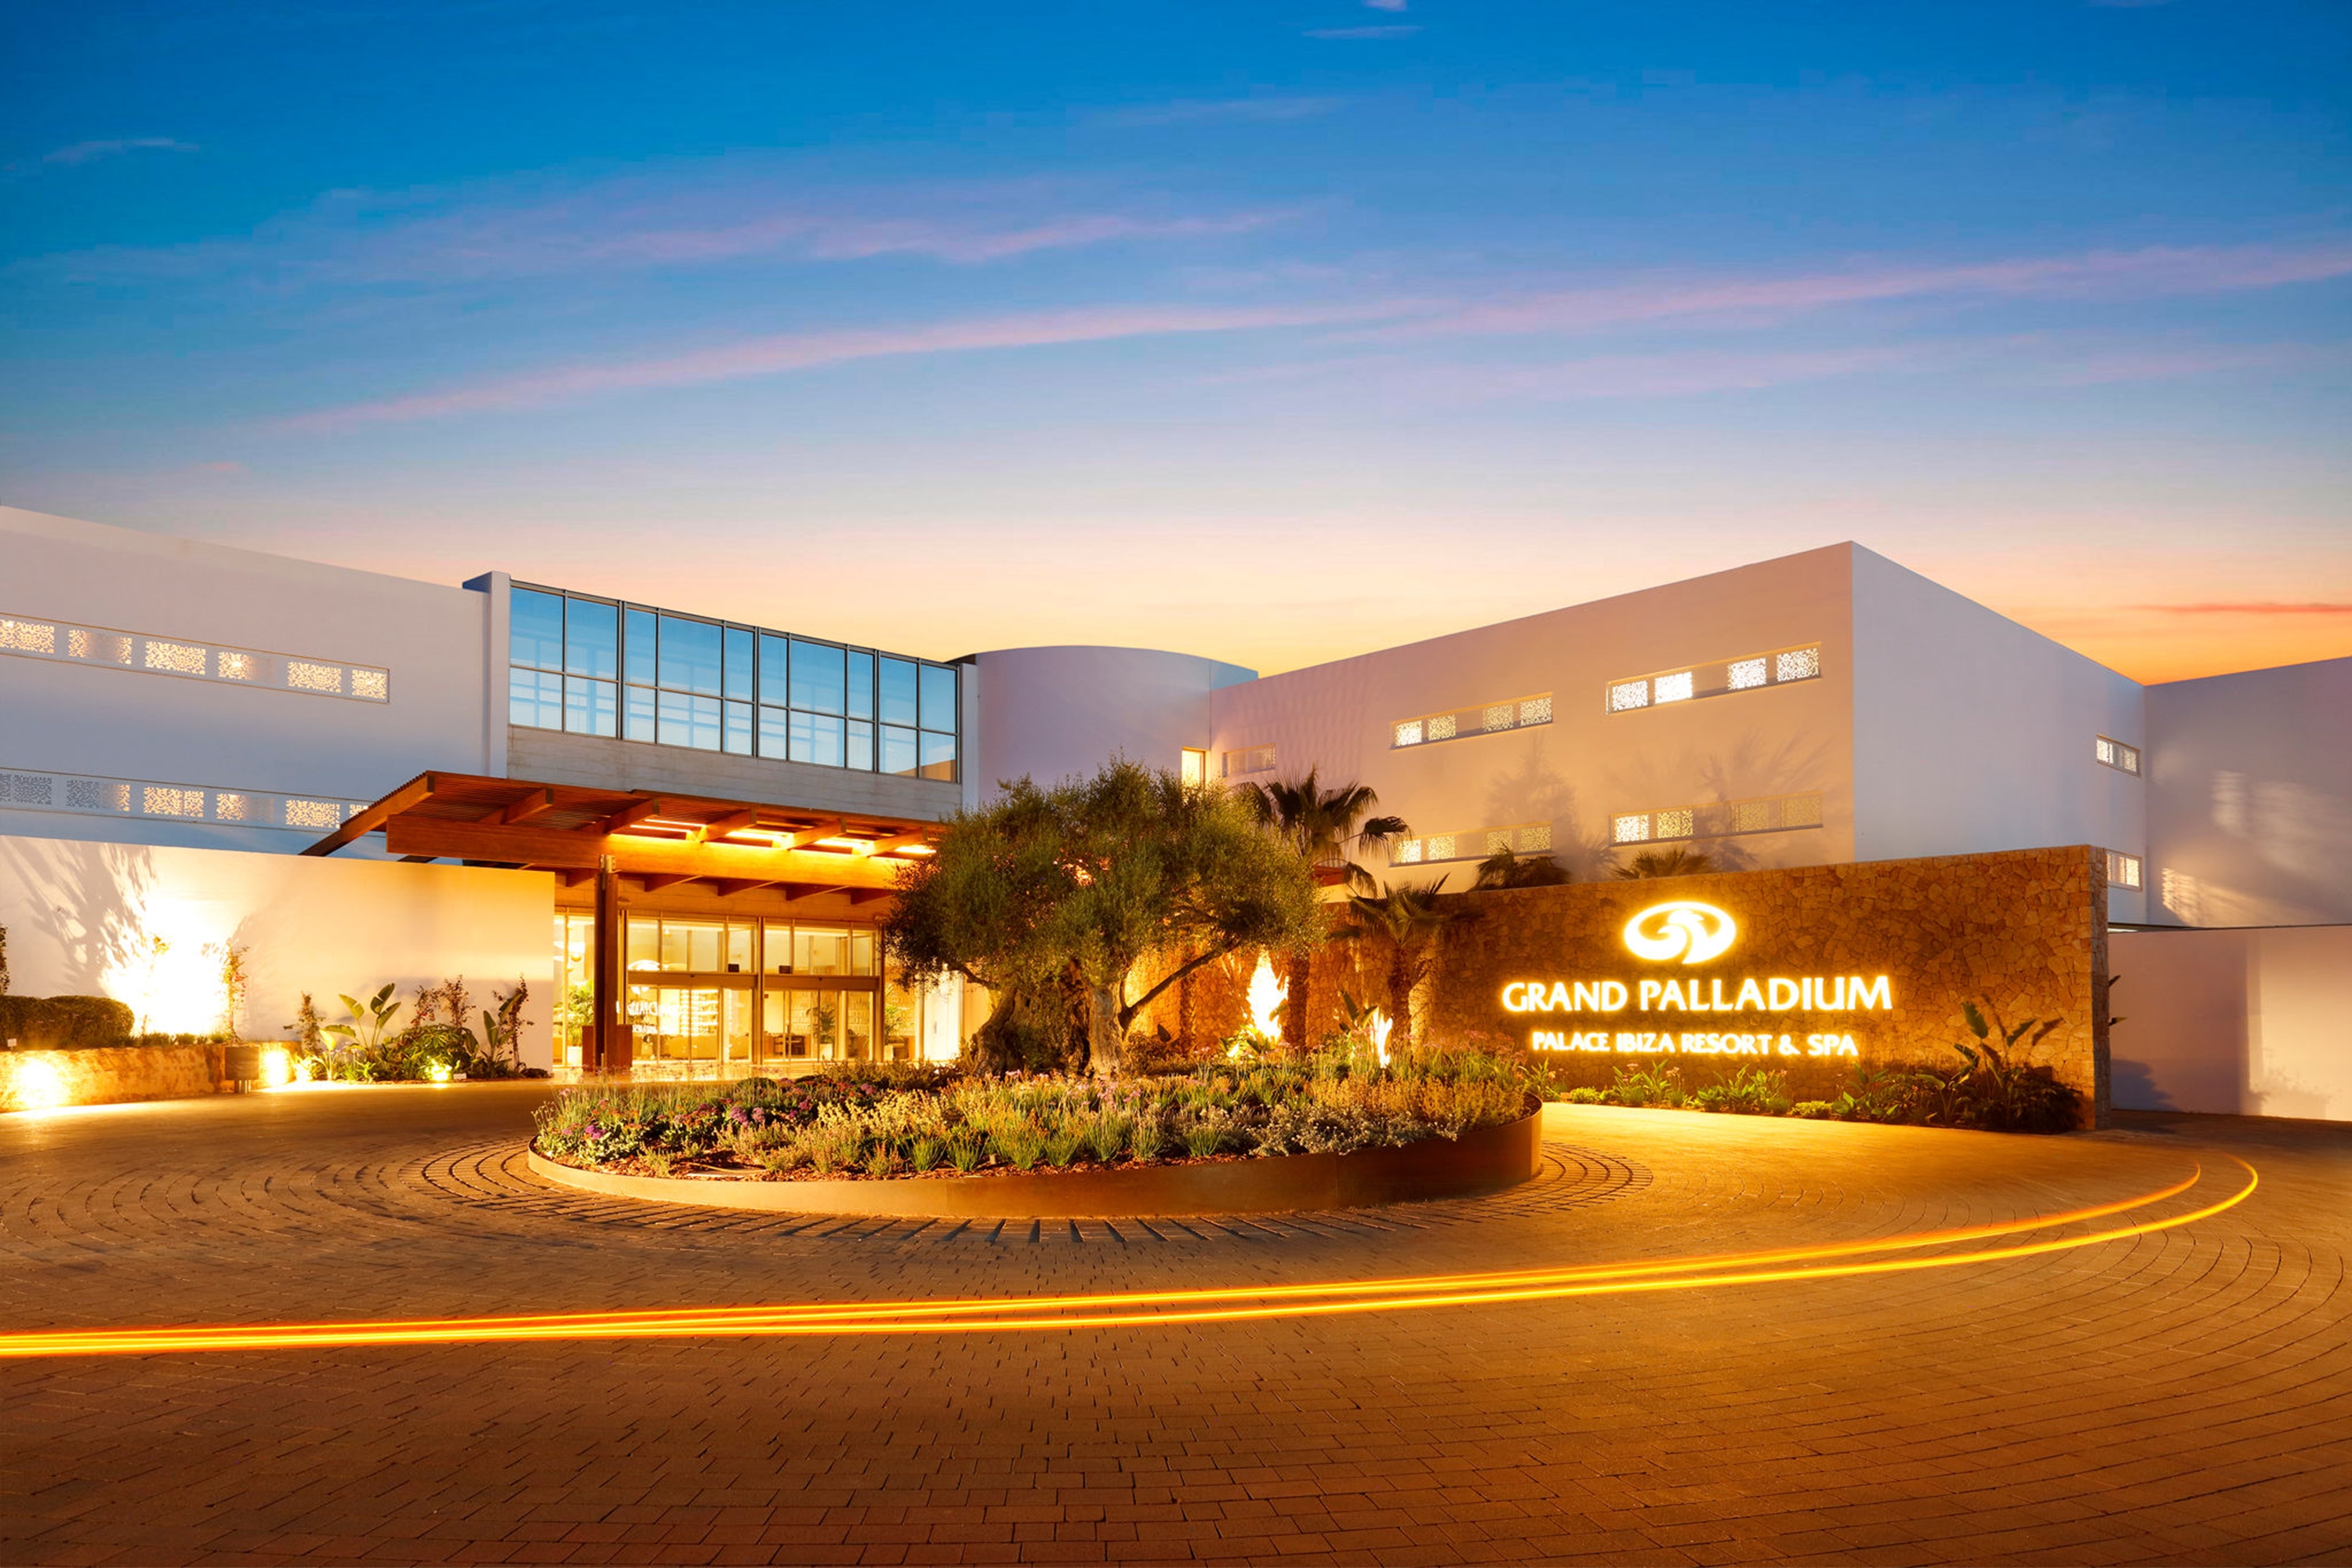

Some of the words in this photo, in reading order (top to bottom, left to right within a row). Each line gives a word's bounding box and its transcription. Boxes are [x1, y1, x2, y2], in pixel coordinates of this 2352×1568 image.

[1502, 981, 1628, 1012] GRAND
[1639, 975, 1893, 1011] PALLADIUM
[1532, 1031, 1611, 1052] PALACE
[1616, 1033, 1675, 1053] IBIZA
[1681, 1033, 1773, 1054] RESORT
[1777, 1034, 1801, 1056] &
[1807, 1034, 1859, 1056] SPA
